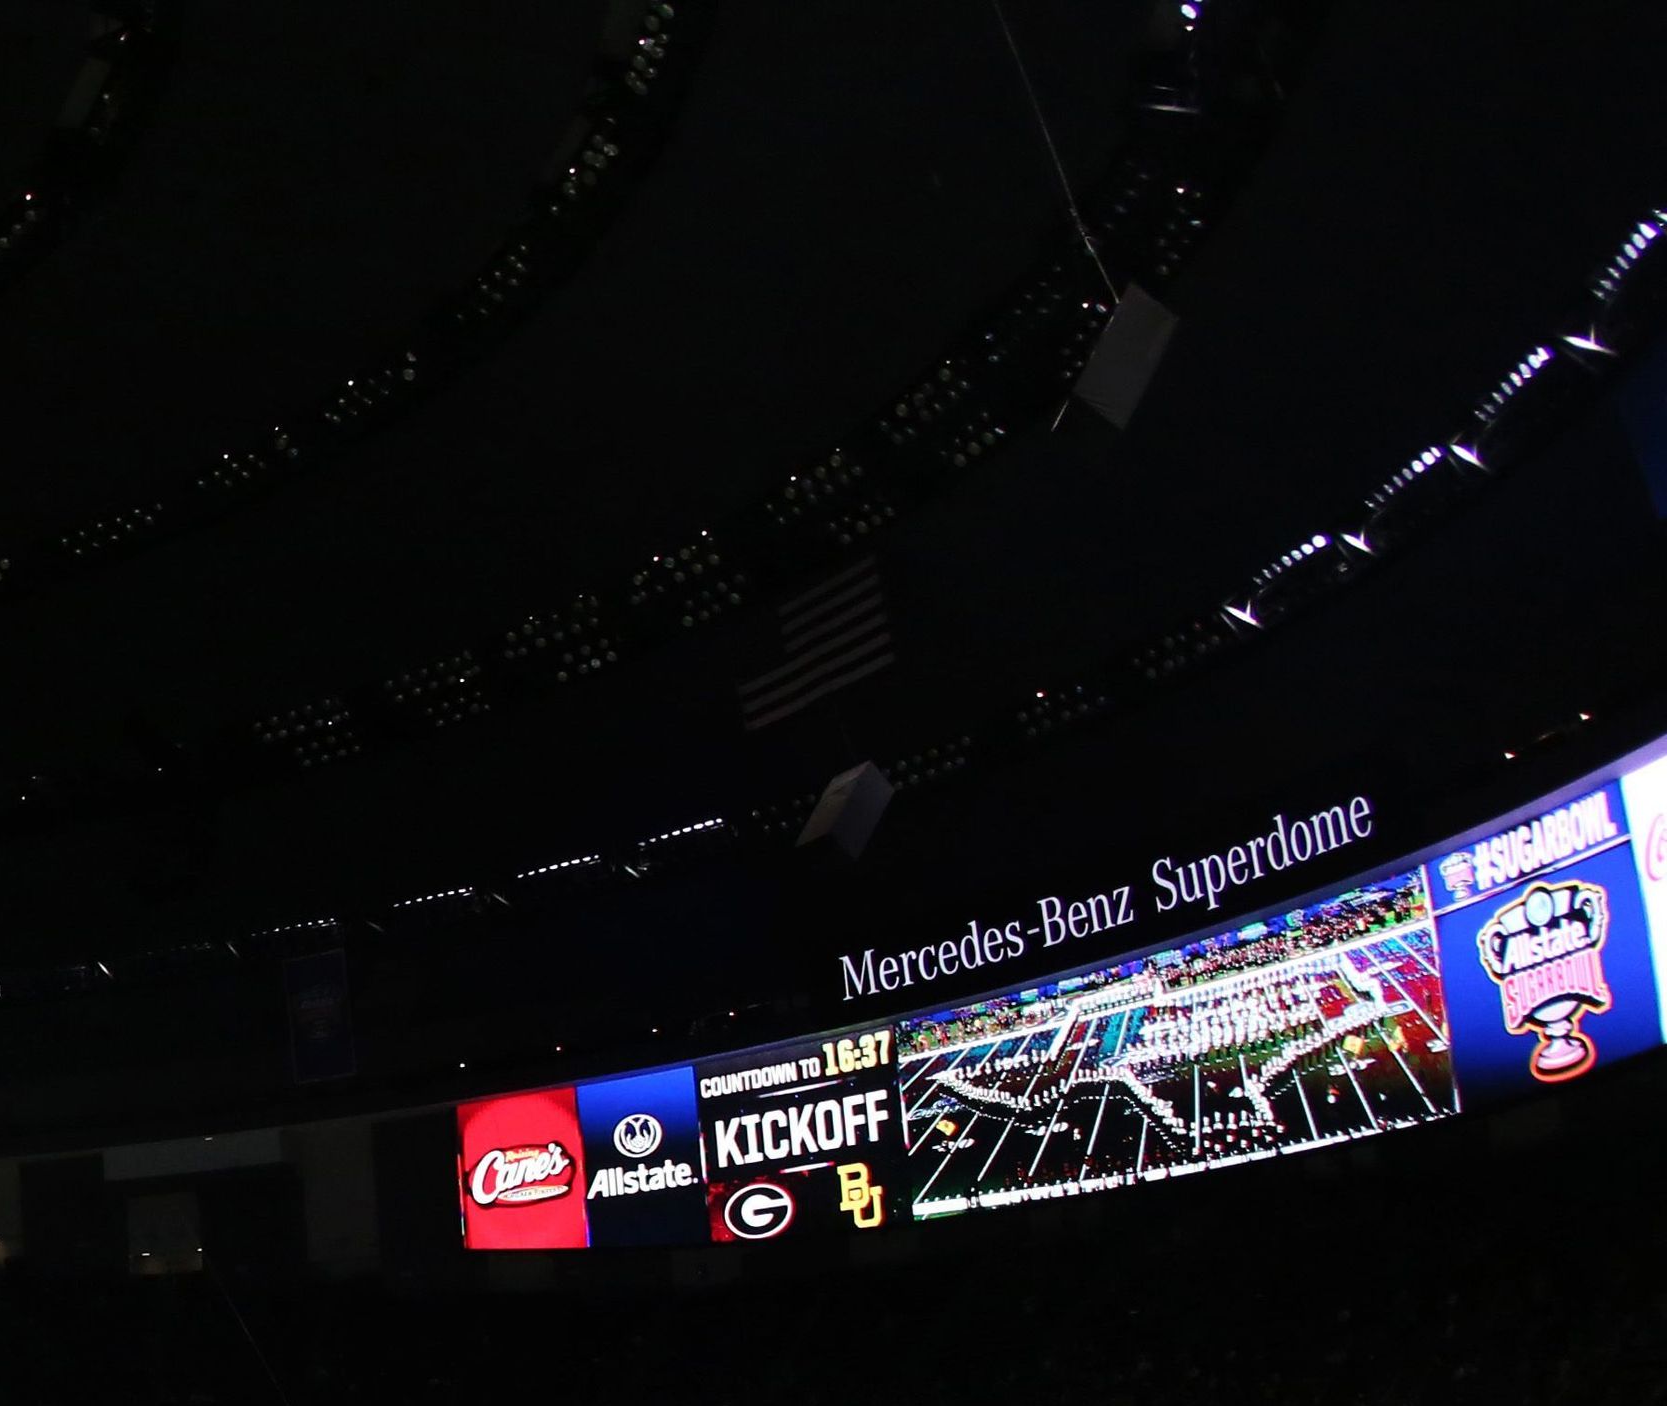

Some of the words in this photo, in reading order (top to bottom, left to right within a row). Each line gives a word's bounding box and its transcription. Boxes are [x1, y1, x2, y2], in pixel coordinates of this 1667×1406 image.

[839, 886, 1134, 1000] Mercedes-Benz
[1152, 796, 1373, 912] Superdome
[700, 1062, 796, 1099] COUNTDOWN
[799, 1057, 821, 1079] TO
[823, 1030, 892, 1076] 16:37
[715, 1090, 888, 1168] KICKOFF
[471, 1142, 570, 1206] Cane's
[587, 1159, 698, 1199] Allstate.
